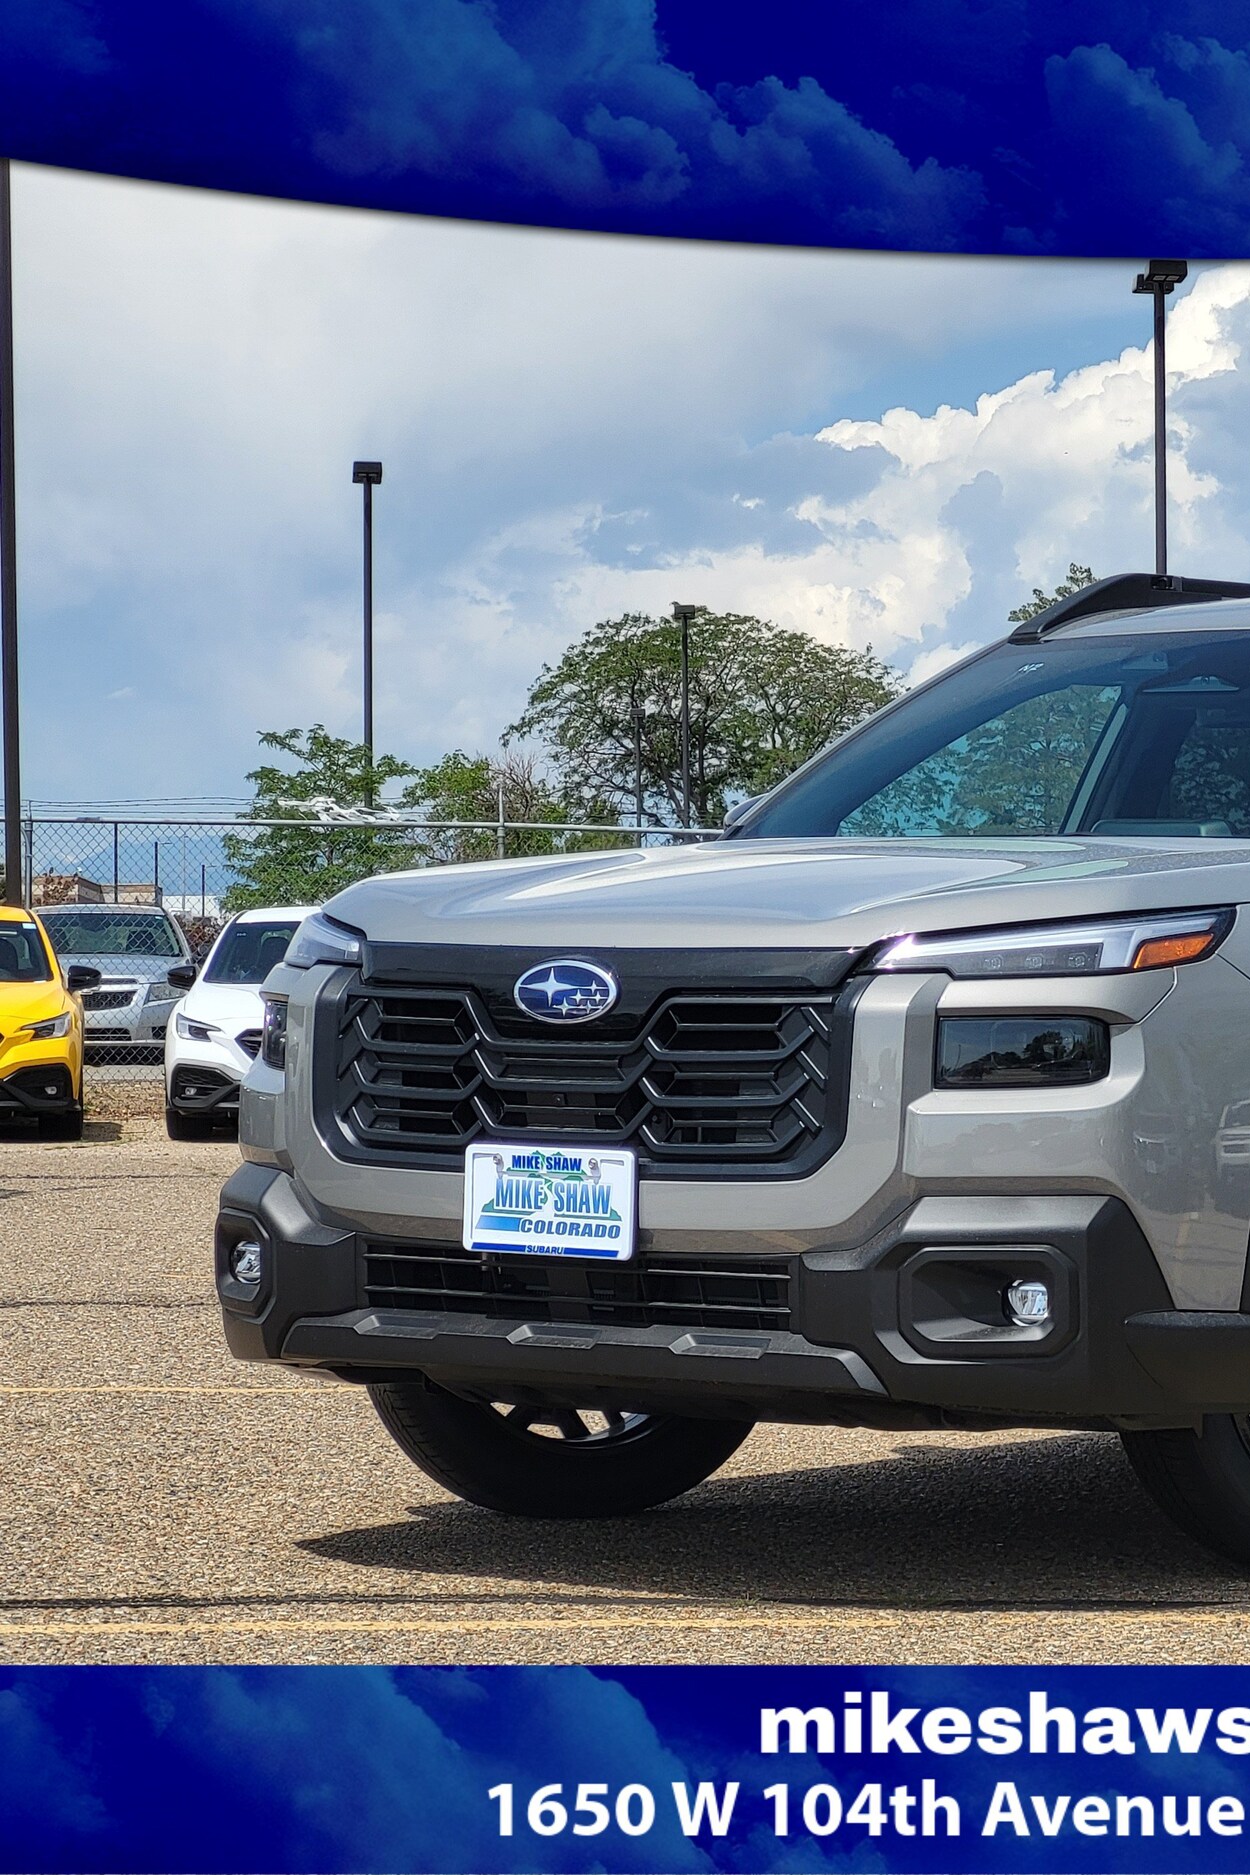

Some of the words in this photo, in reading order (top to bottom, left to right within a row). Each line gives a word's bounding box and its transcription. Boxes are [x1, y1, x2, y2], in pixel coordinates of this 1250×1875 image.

[511, 1154, 541, 1170] MIKE
[545, 1156, 582, 1172] SHAW
[495, 1178, 544, 1210] MIKE
[553, 1182, 612, 1215] SHAW
[520, 1218, 621, 1240] COLORADO
[526, 1244, 564, 1255] SUBARU
